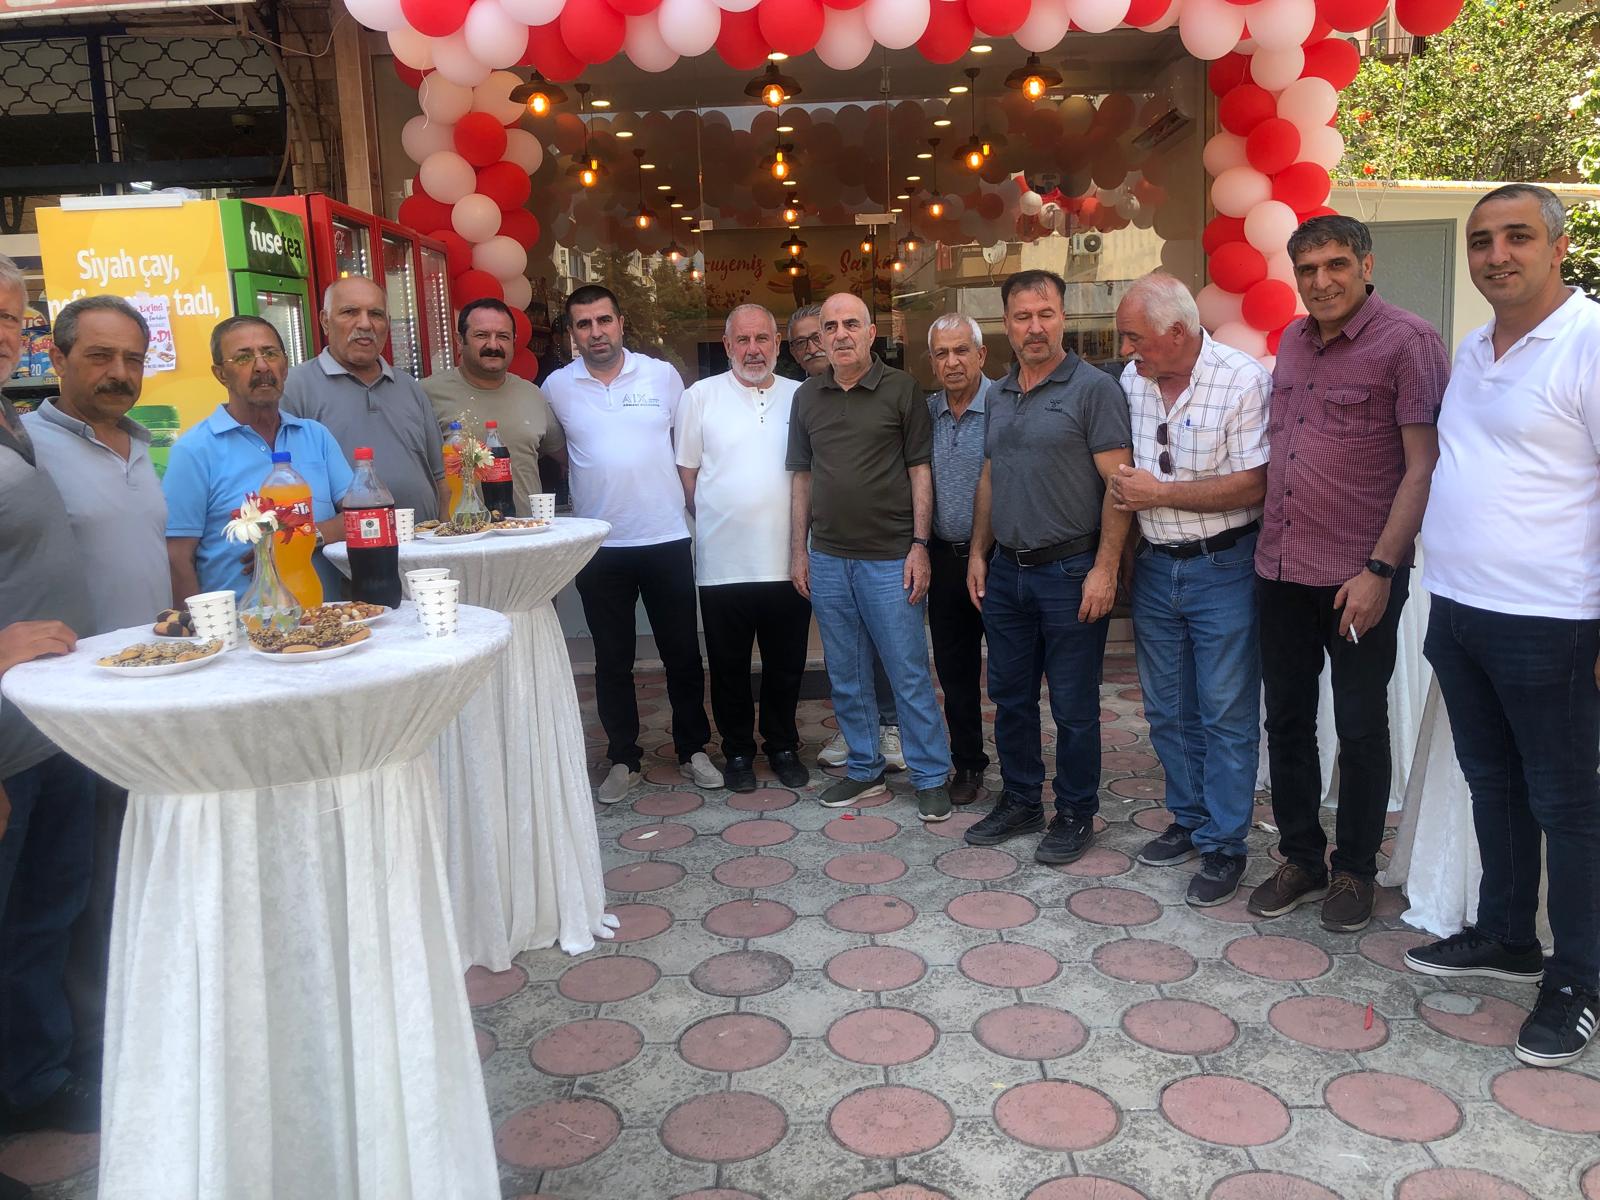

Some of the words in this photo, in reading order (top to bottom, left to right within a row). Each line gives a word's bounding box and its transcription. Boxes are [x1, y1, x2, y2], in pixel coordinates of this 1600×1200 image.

[249, 221, 303, 259] fusetea
[76, 248, 136, 288] Siyah
[138, 254, 180, 288] çay,
[173, 285, 220, 319] tadı,
